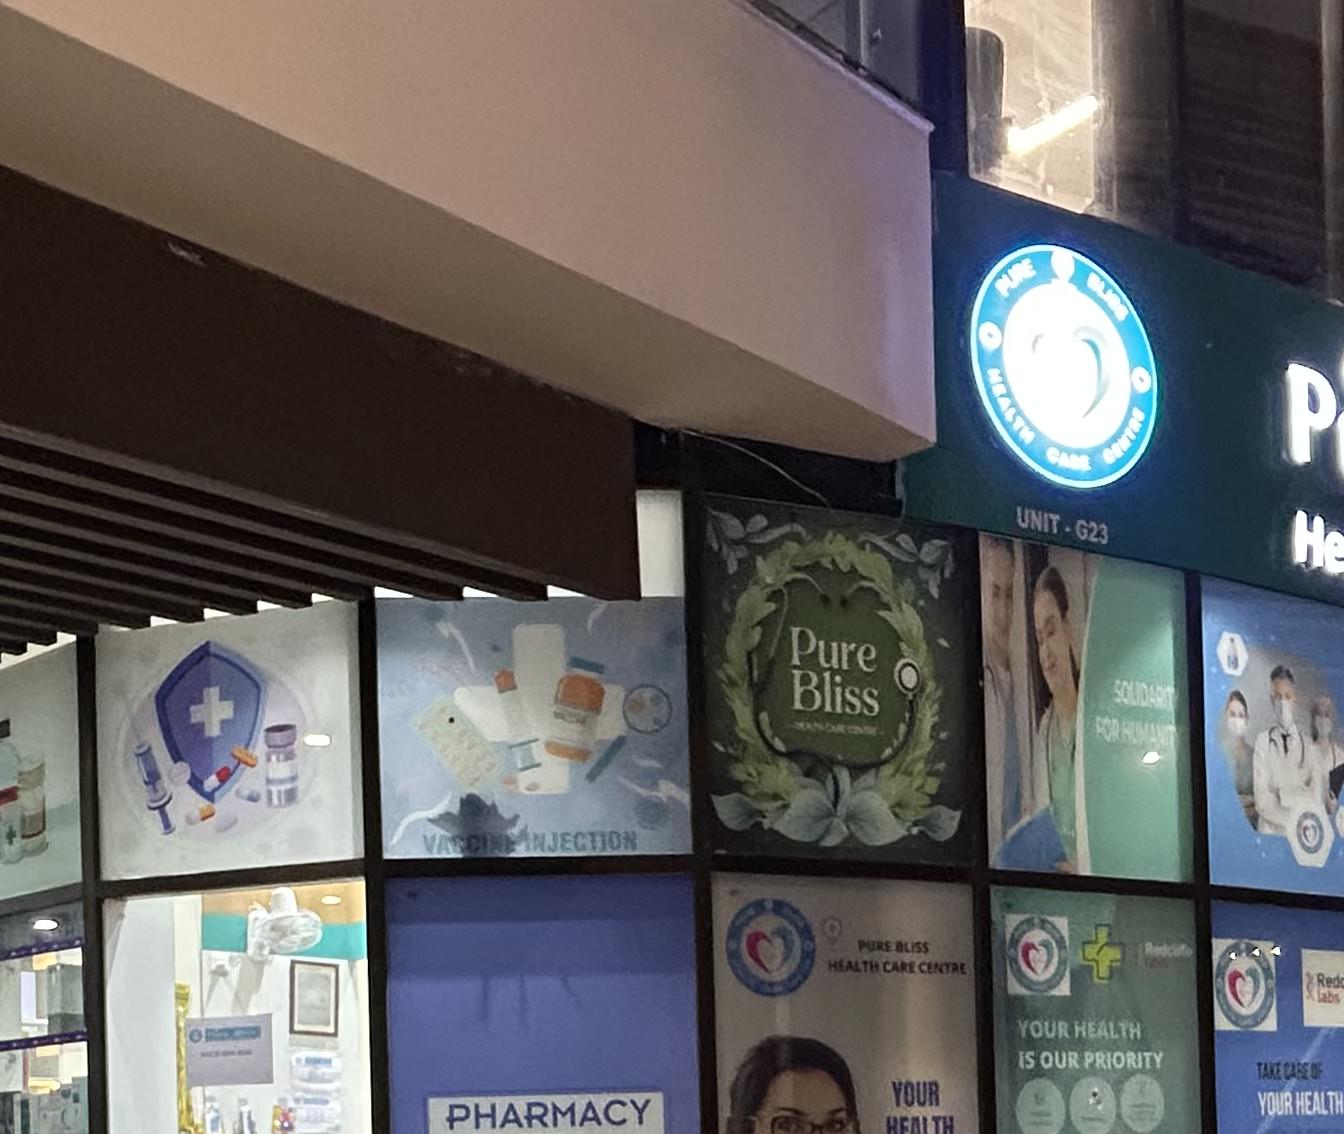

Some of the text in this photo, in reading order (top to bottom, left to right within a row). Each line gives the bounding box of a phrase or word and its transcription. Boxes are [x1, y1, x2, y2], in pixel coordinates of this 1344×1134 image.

[996, 259, 1036, 298] PURE
[987, 367, 1035, 443] HEALTH
[1046, 446, 1091, 472] CARE
[1016, 506, 1060, 534] UNIT
[1075, 520, 1109, 544] G23
[789, 626, 877, 673] Pure
[792, 670, 880, 717] Bliss
[1096, 716, 1119, 742] FOR
[423, 830, 637, 854] VACCINE INJECTION
[858, 939, 929, 955] PURE BLISS
[828, 960, 967, 975] HEALTH CARE CENTRE
[1017, 1020, 1142, 1039] YOUR HEALTH
[1018, 1051, 1164, 1069] IS OUR PRIORITY
[1257, 1062, 1323, 1081] TAKE CARE OF
[892, 1081, 940, 1107] YOUR
[1258, 1091, 1344, 1116] YOUR HEALTH
[446, 1099, 651, 1130] PHARMACY
